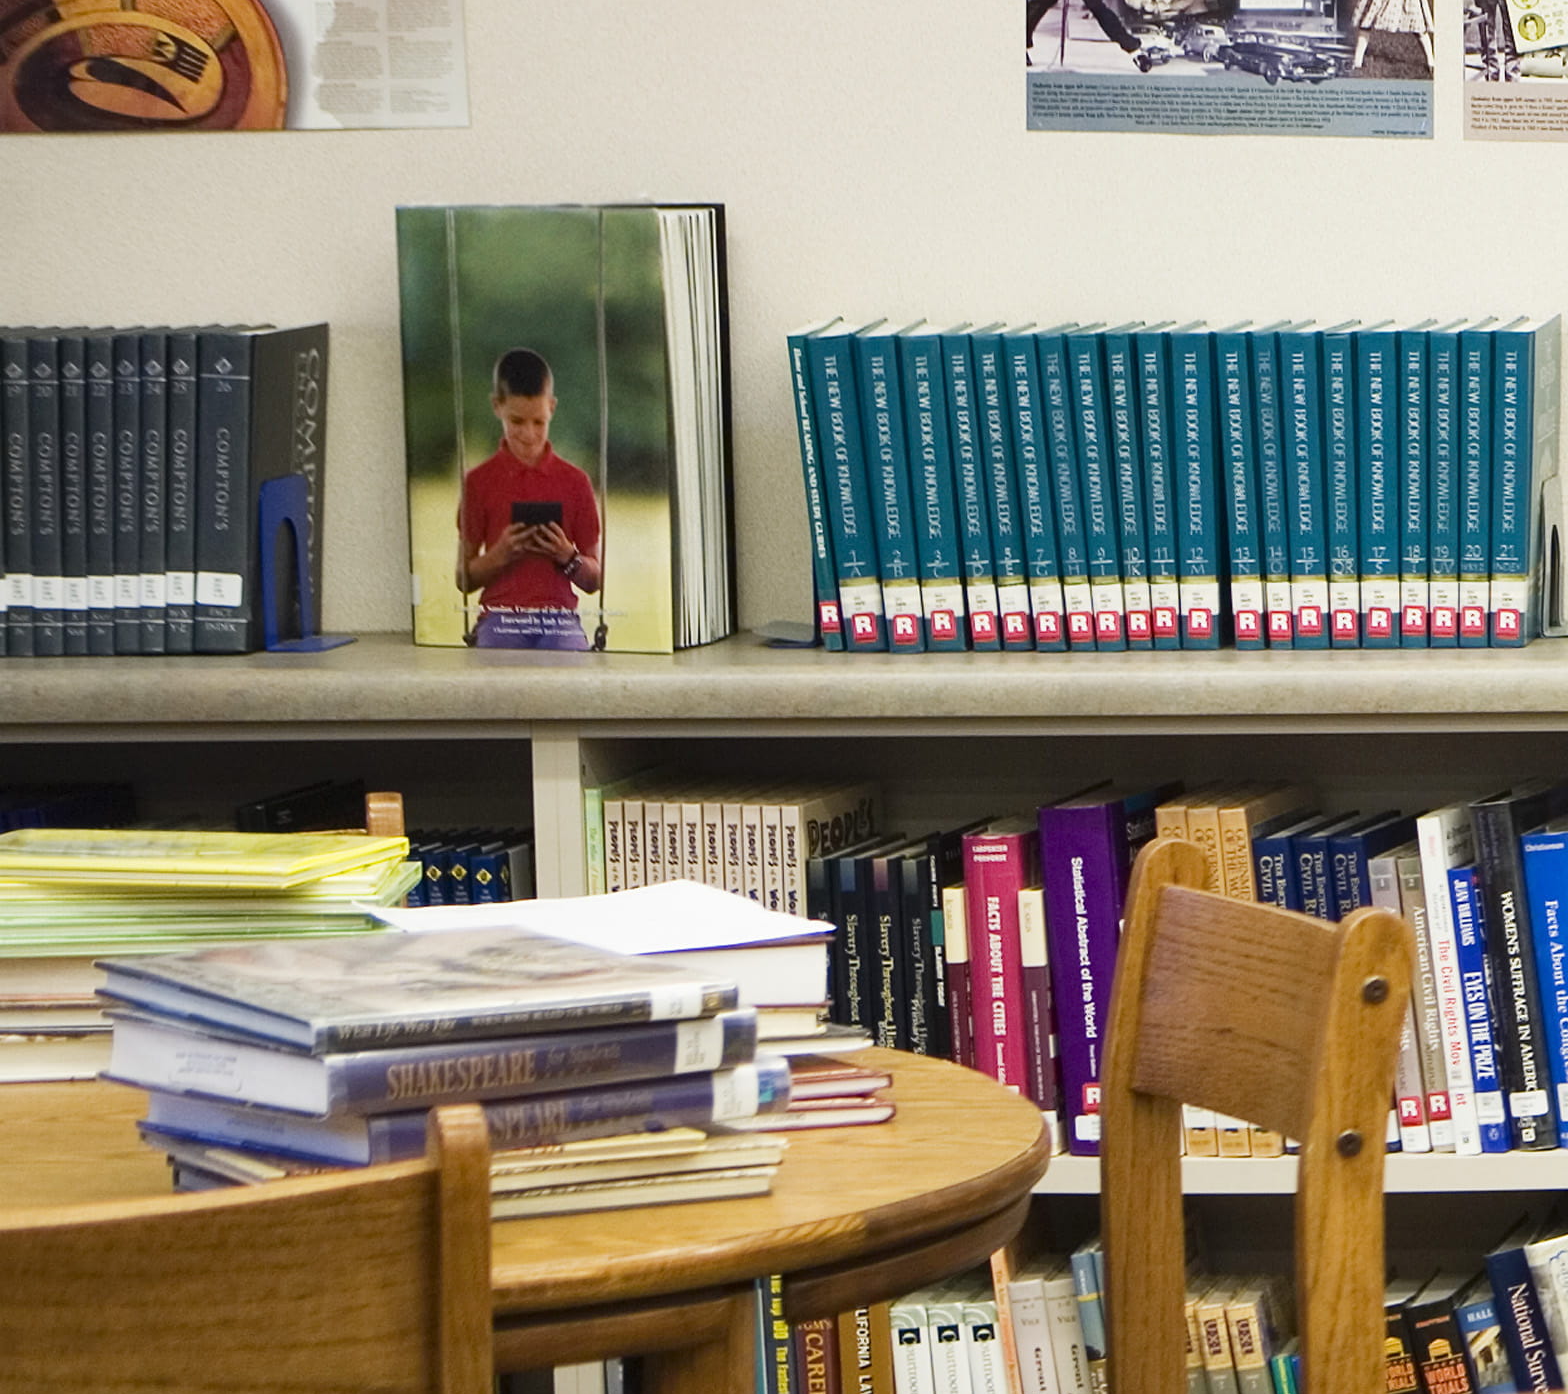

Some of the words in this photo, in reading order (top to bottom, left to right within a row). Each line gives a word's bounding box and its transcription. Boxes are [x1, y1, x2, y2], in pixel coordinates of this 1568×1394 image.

[214, 428, 230, 532] COMPTON'S
[1071, 857, 1087, 915] Statistical
[987, 896, 1001, 931] FACTS
[1544, 899, 1560, 939] Facts
[989, 933, 1004, 973] ABOUT
[1076, 916, 1091, 966] Abstract
[1080, 968, 1091, 981] of
[1550, 941, 1566, 990] About
[991, 977, 1005, 998] THE
[1082, 982, 1093, 1002] the
[1556, 993, 1568, 1013] the
[992, 1000, 1006, 1036] CITIES
[1084, 1003, 1097, 1038] World
[387, 1053, 535, 1099] SHAKESPEARE
[1425, 1361, 1467, 1381] WORLD
